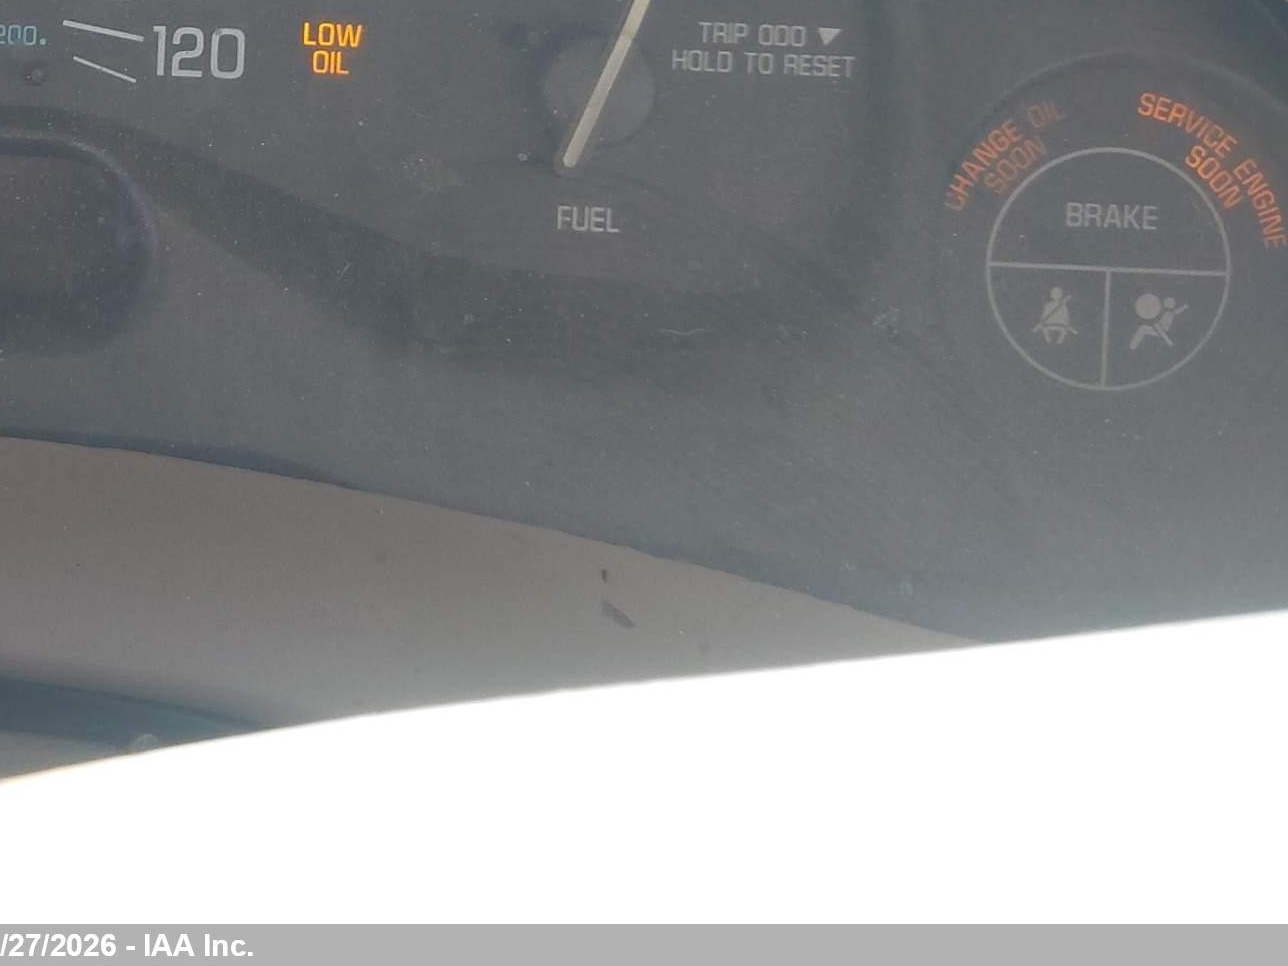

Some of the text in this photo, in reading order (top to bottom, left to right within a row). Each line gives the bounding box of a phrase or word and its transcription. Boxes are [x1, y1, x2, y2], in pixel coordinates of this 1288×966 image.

[303, 22, 362, 47] LOW
[698, 22, 806, 47] TRIP ODO
[152, 25, 245, 79] 120
[312, 51, 348, 75] OIL
[672, 50, 855, 78] HOLD TO RESET
[943, 101, 1066, 211] CHANGE OIL
[983, 136, 1048, 196] SOON
[1137, 92, 1288, 250] SERVICE ENGINE
[1186, 145, 1241, 209] SOON
[557, 206, 619, 233] FUEL
[1065, 202, 1158, 230] BRAKE
